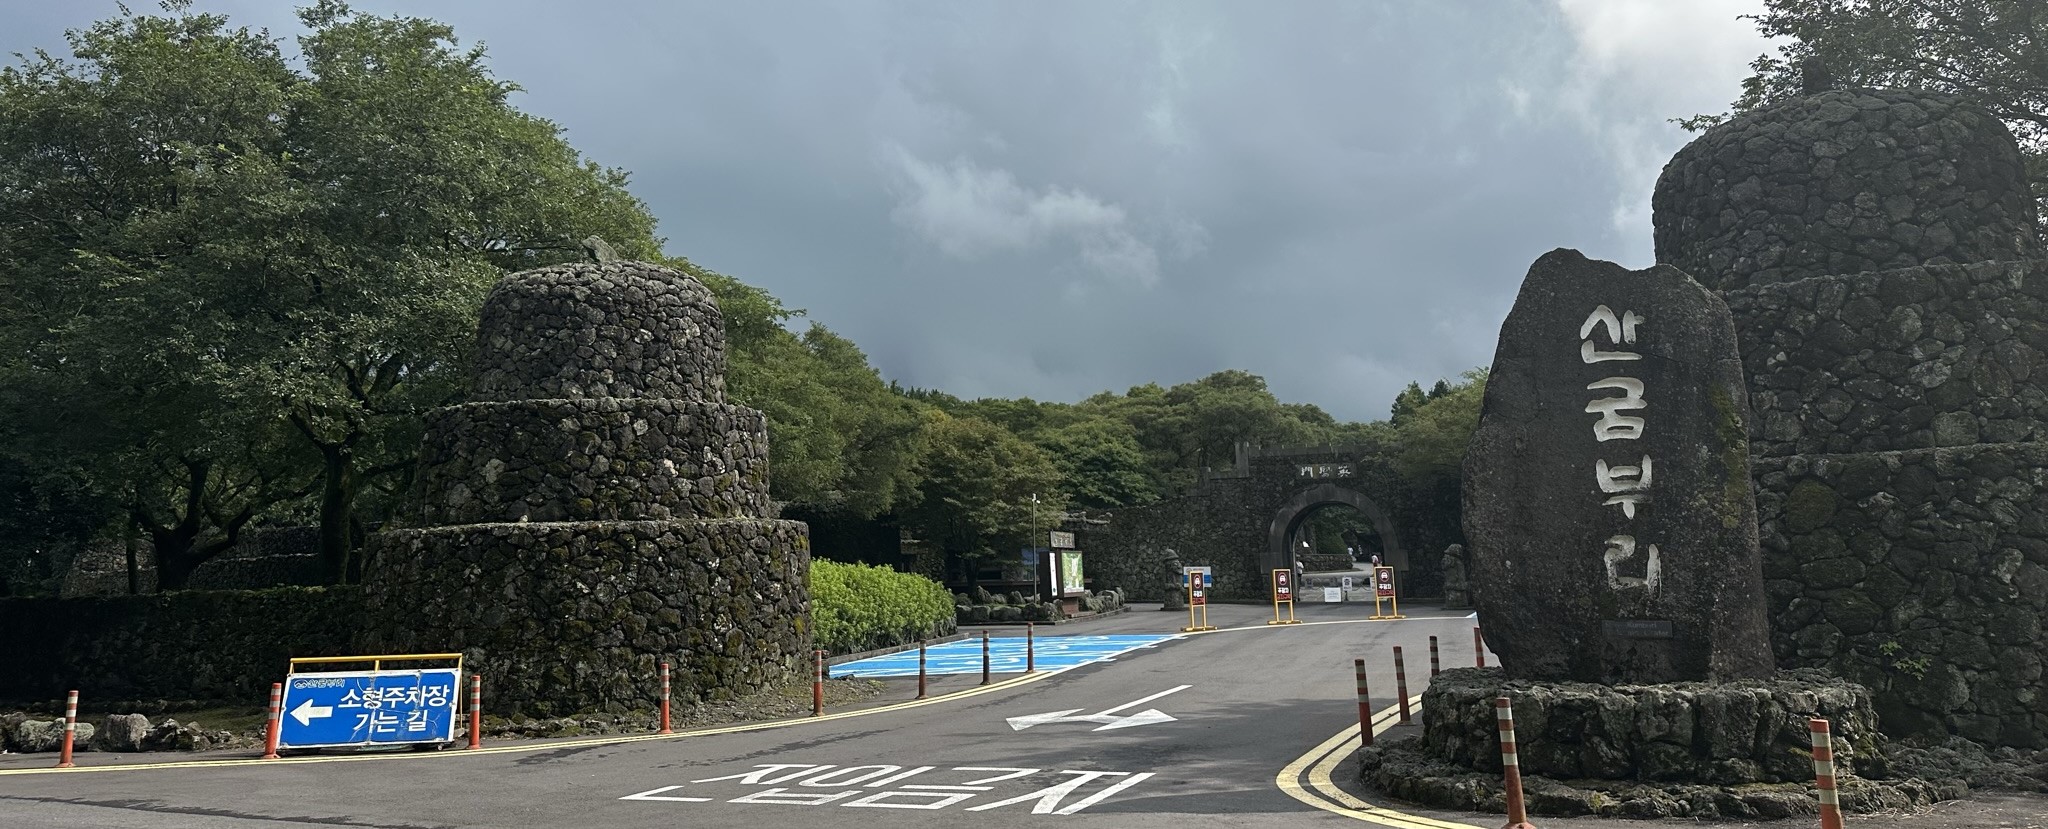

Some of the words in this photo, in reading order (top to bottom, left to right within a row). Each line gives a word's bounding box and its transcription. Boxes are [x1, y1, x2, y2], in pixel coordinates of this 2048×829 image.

[1579, 304, 1662, 600] 산굼부리
[338, 685, 450, 709] 소형주차장
[353, 710, 399, 733] 가는
[407, 709, 428, 732] 길
[618, 764, 1157, 816] 진입금지
